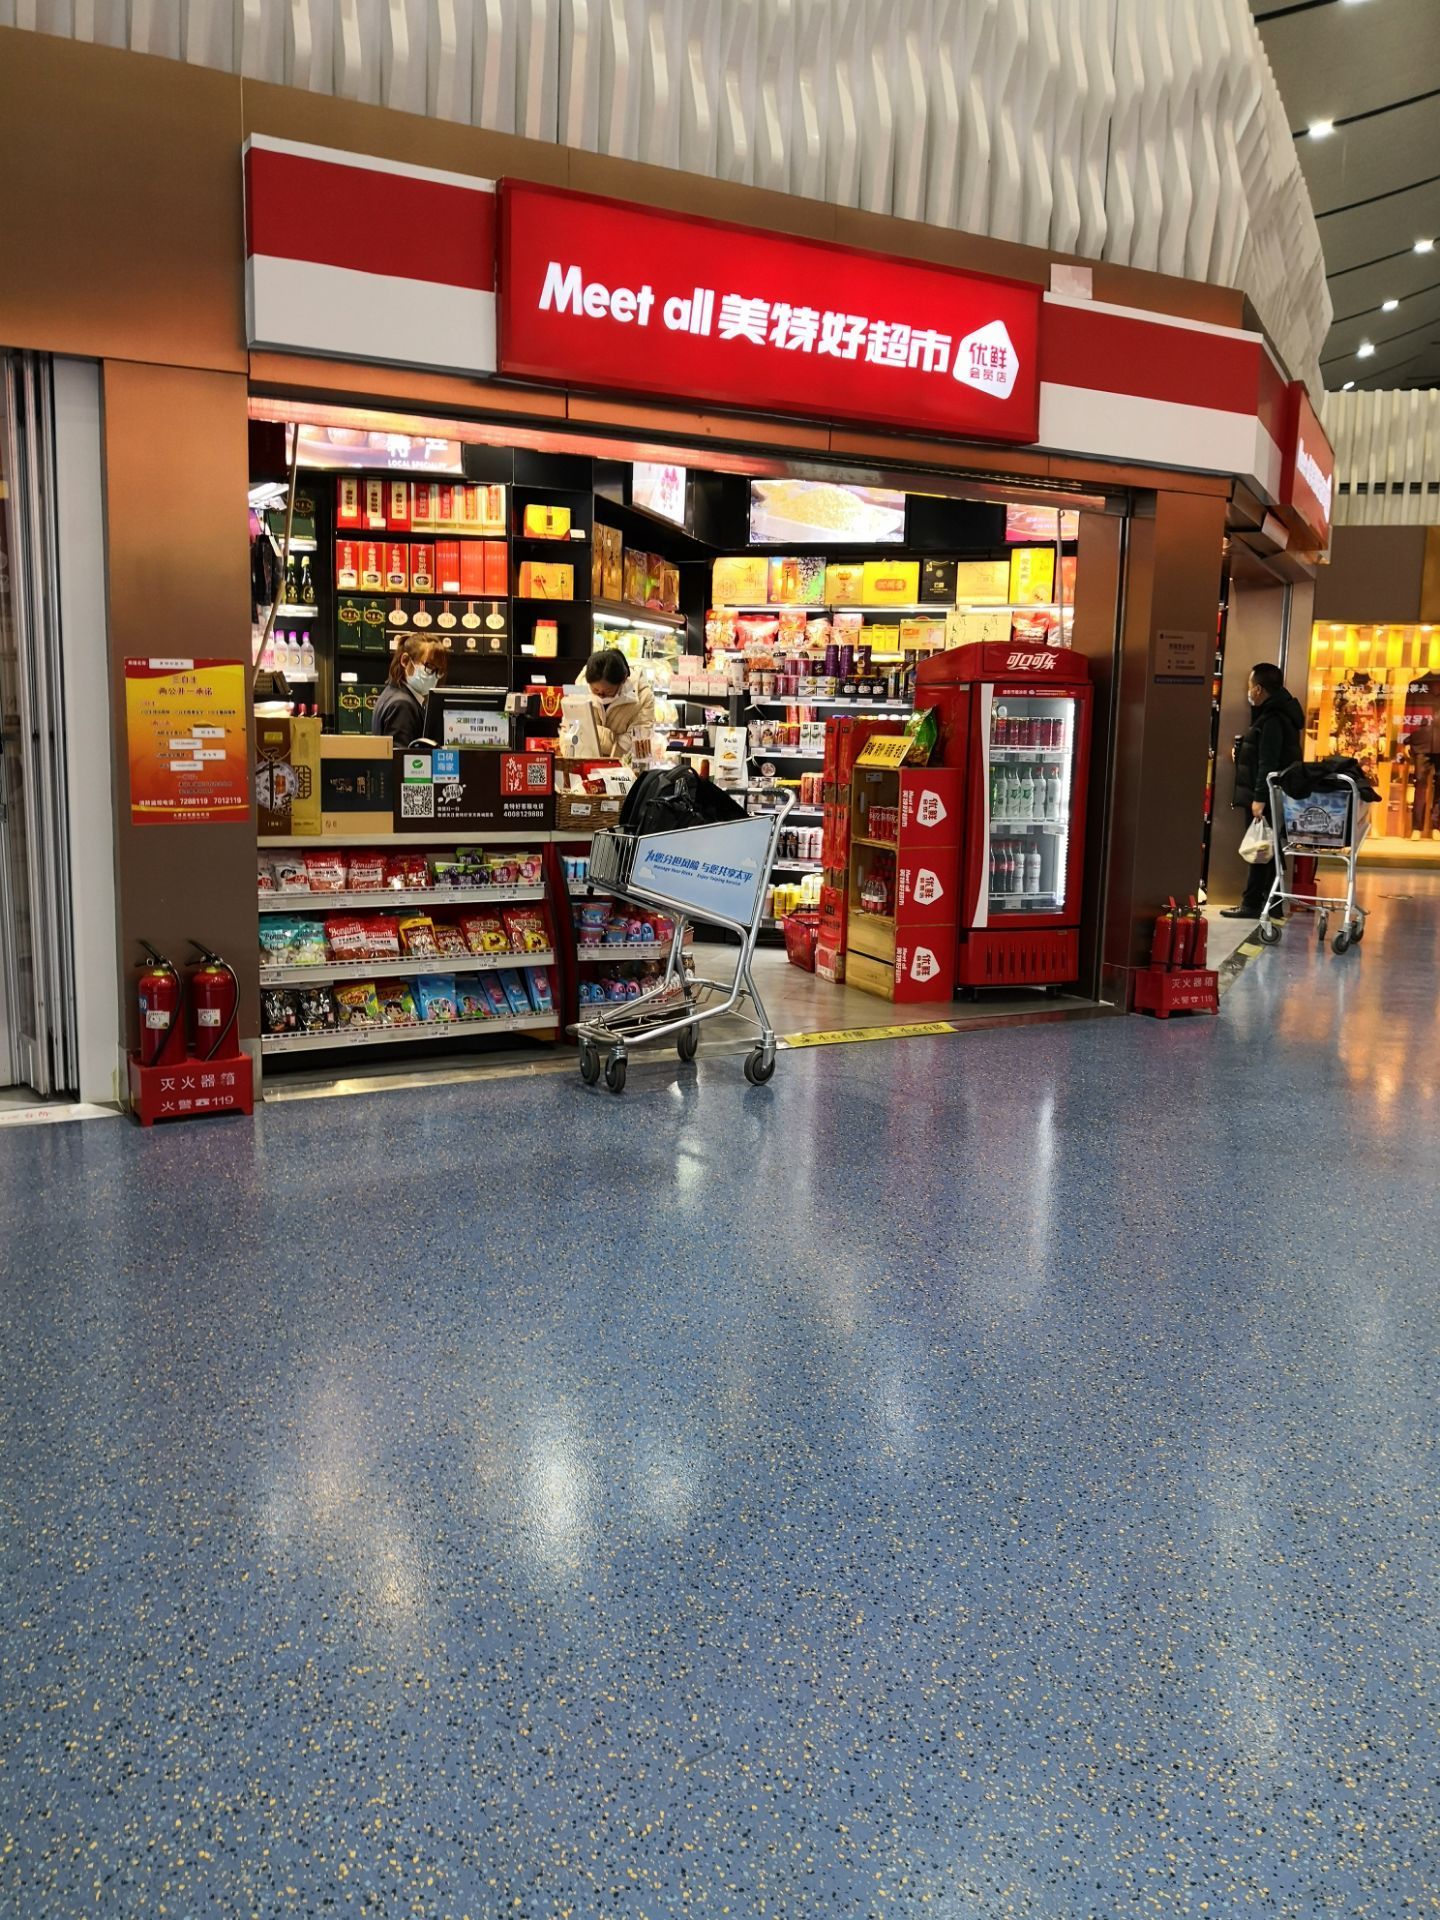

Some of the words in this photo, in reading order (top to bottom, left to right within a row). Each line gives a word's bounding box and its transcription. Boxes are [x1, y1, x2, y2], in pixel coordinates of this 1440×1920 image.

[538, 261, 655, 326] Meet
[663, 287, 715, 336] all
[718, 294, 952, 373] 美特好超市
[969, 341, 1008, 369] 优鲜
[969, 367, 1007, 384] 会员店
[388, 459, 411, 468] LOCAL
[1006, 651, 1060, 672] 可口可乐
[928, 798, 938, 820] 优鲜
[644, 849, 700, 871] 为您分担风险
[701, 861, 753, 884] 与您共享太平
[925, 876, 935, 899] 优鲜
[921, 954, 931, 976] 优鲜
[1171, 976, 1214, 989] 灭火器箱
[160, 1072, 236, 1092] 灭火器箱
[211, 1095, 235, 1106] 119
